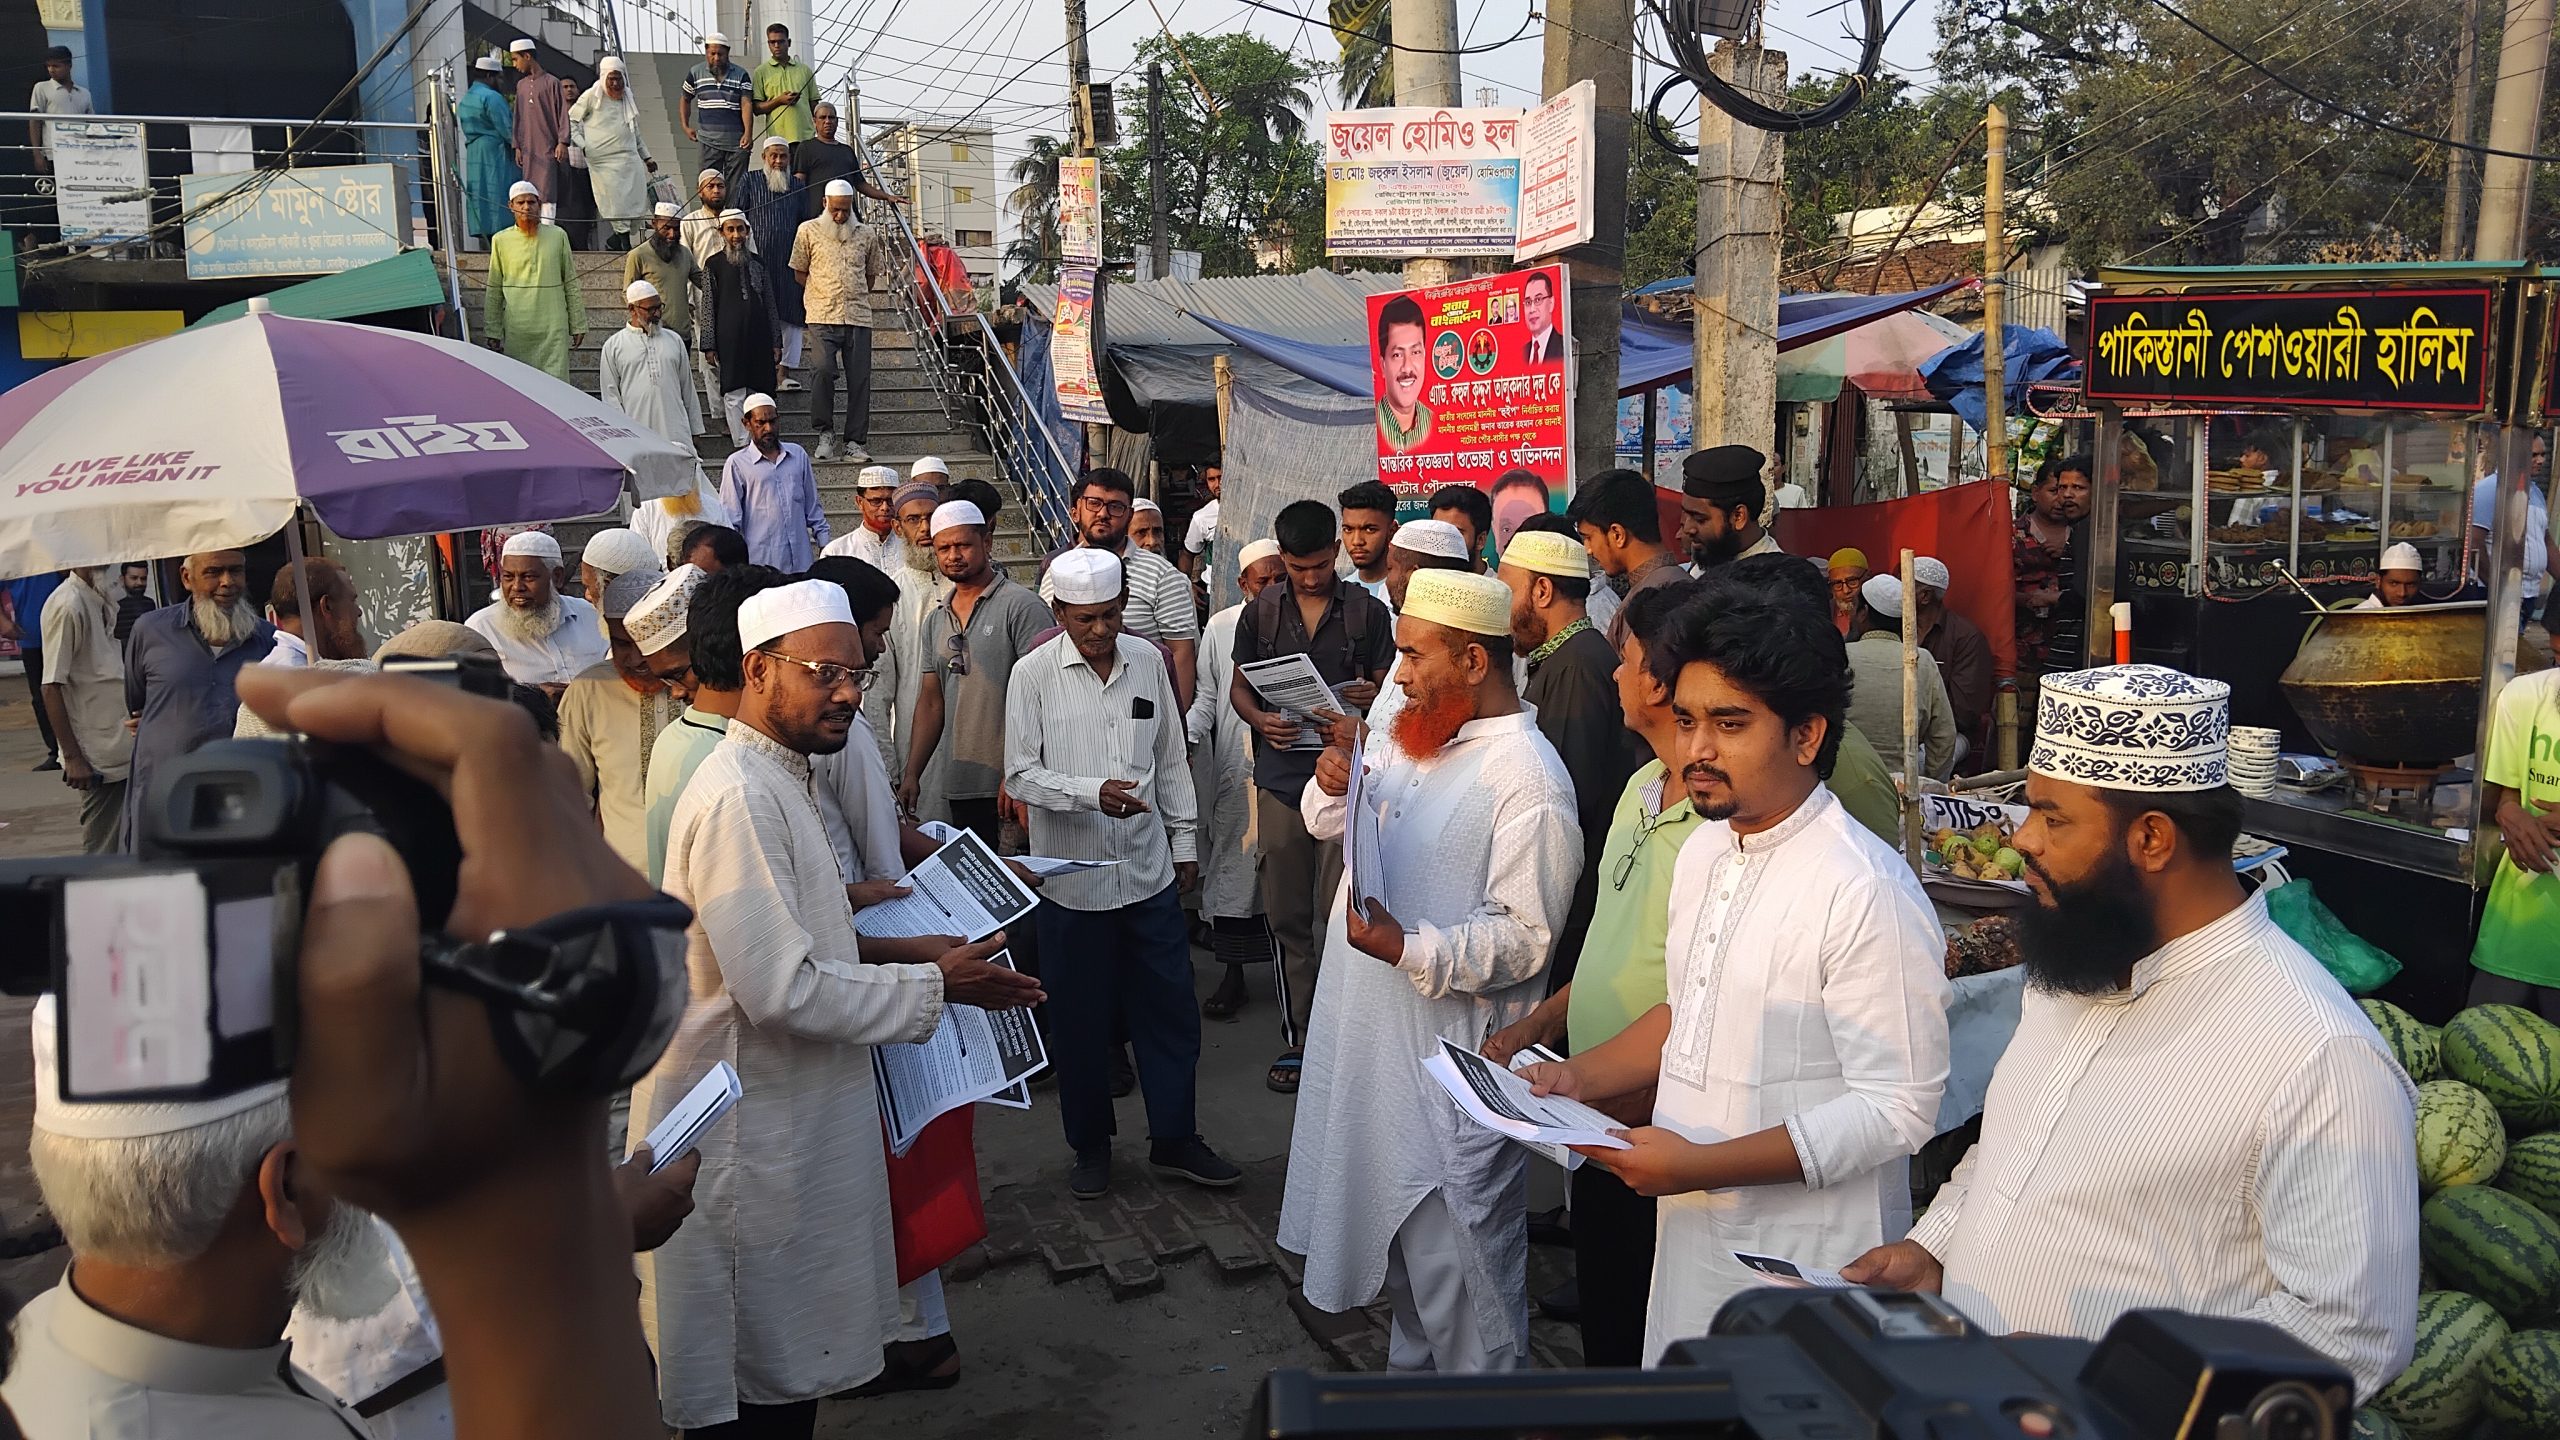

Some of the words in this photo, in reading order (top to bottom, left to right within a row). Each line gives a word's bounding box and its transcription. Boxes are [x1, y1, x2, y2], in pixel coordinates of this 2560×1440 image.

[1329, 122, 1395, 160] জুয়েল
[1403, 110, 1474, 154] হোমিও
[1481, 119, 1519, 153] হল
[2098, 308, 2213, 379] পাকিস্তানী
[2221, 305, 2367, 383] পেশওয়ারী
[2374, 306, 2474, 391] হালিম
[1548, 372, 1561, 396] কে
[49, 456, 124, 477] LIVE
[124, 450, 195, 468] LIKE
[1498, 451, 1508, 467] ও
[1510, 442, 1563, 468] অভিনন্দন
[15, 475, 87, 497] YOU
[87, 467, 186, 487] MEAN
[186, 465, 221, 480] IT
